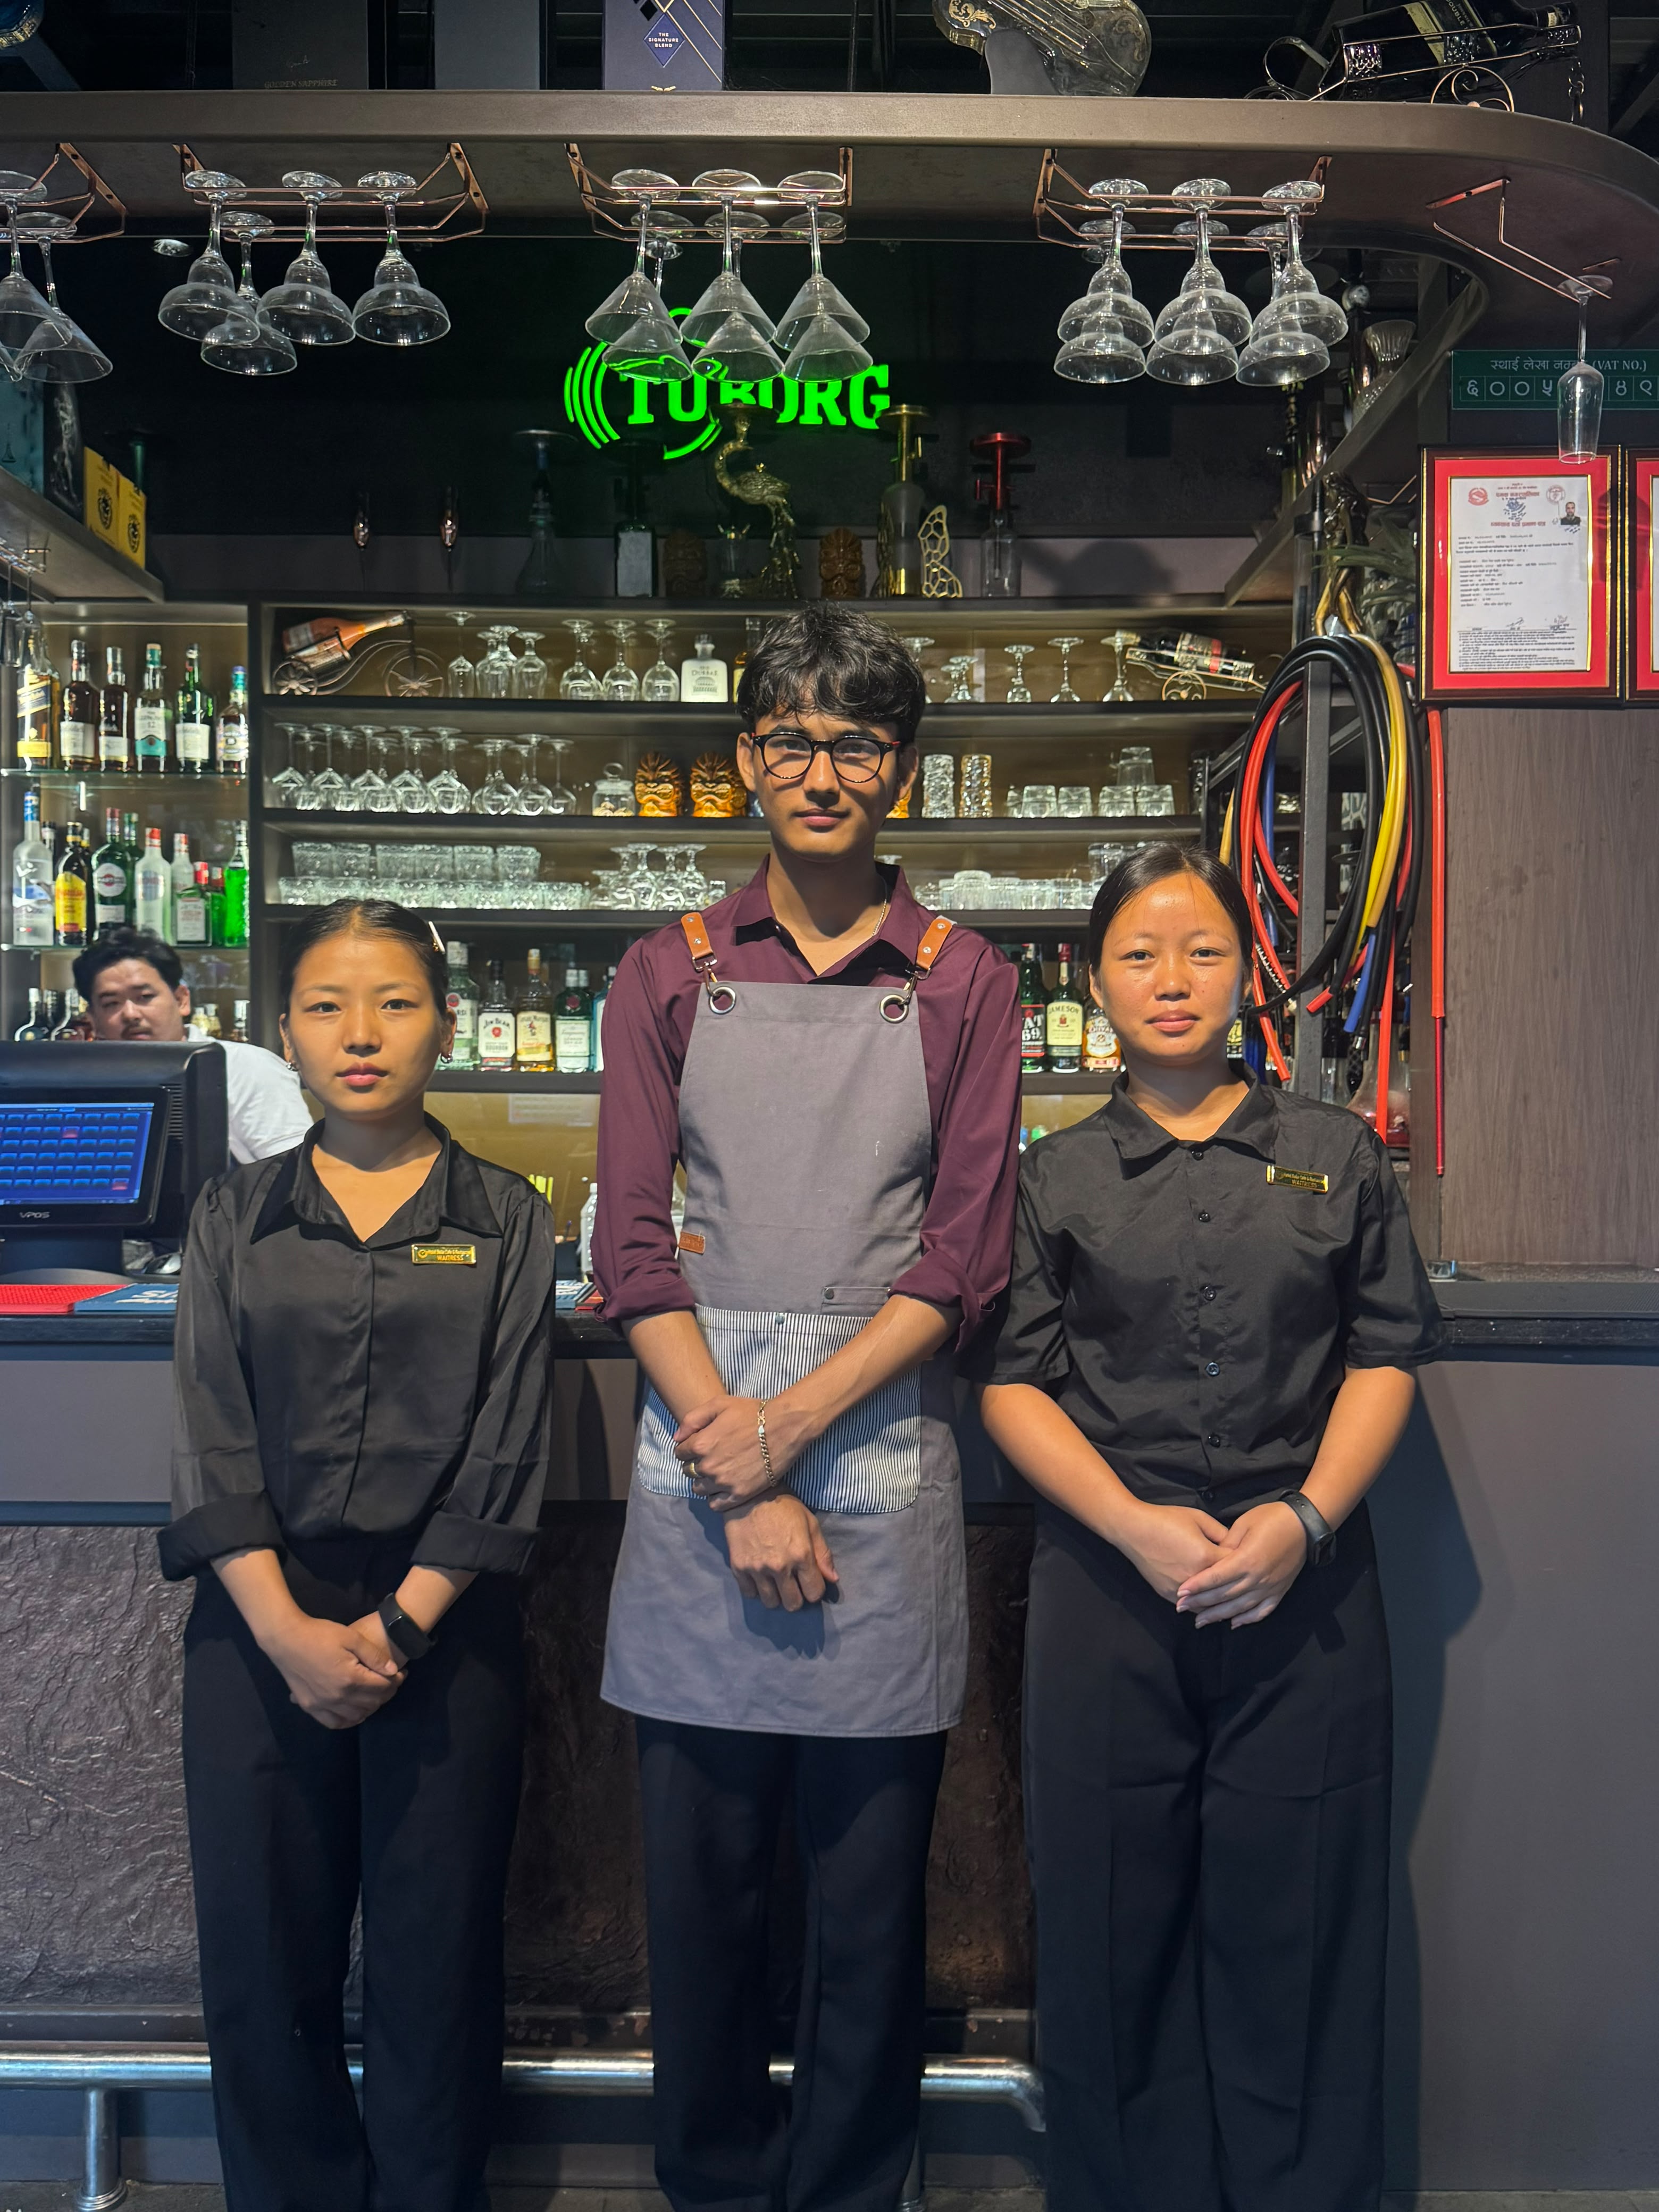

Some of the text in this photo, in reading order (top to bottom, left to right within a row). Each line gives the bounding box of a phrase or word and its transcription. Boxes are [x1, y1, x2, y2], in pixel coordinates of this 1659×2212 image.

[1490, 356, 1520, 370] स्थाई
[1523, 357, 1548, 370] लेखा
[1593, 360, 1619, 371] (VAT
[1622, 360, 1647, 372] NO.)
[1049, 1004, 1079, 1015] JAMESON
[1022, 1014, 1043, 1029] AT
[1021, 1027, 1042, 1041] 69.
